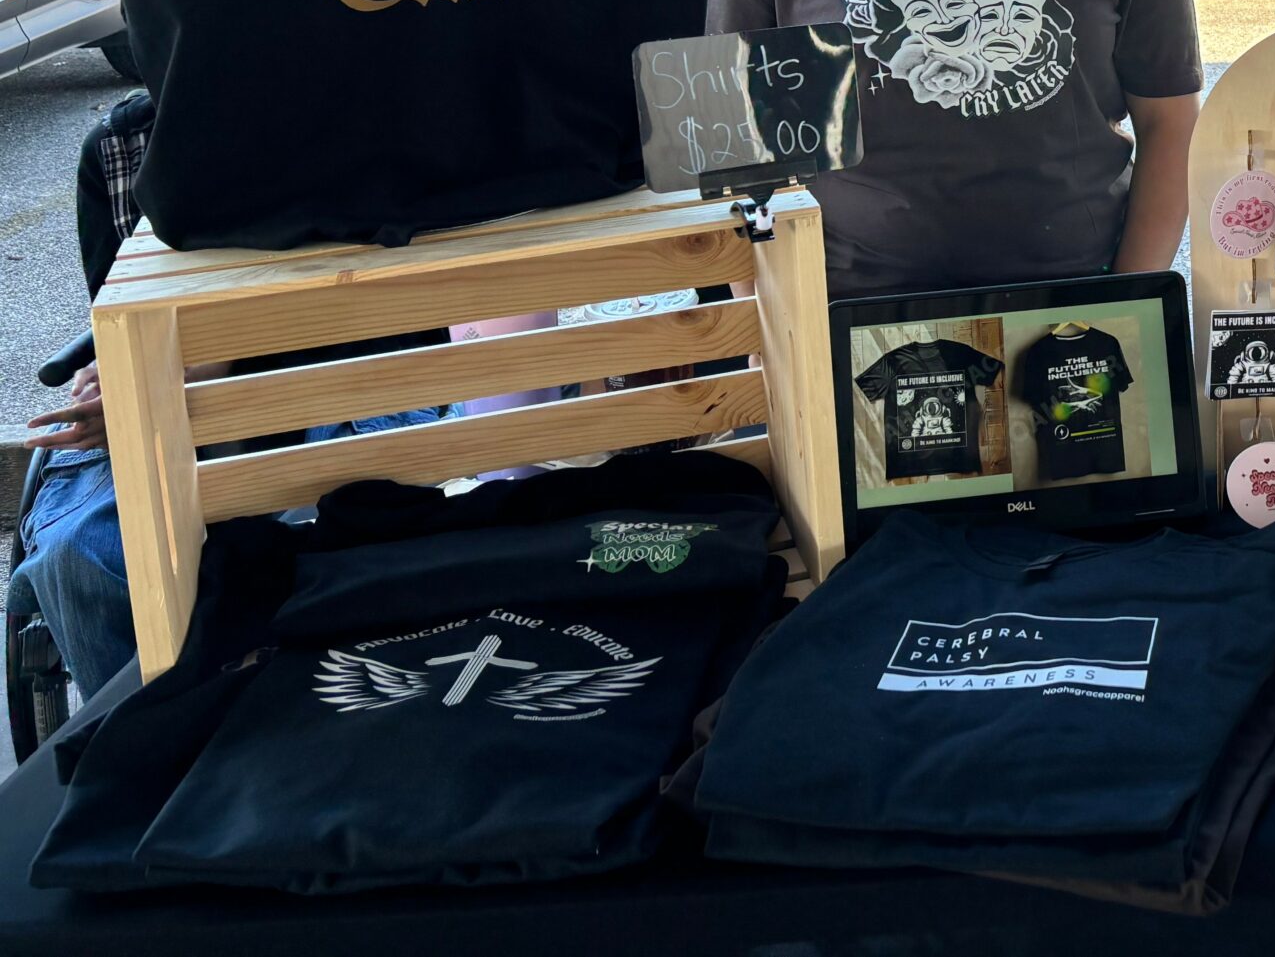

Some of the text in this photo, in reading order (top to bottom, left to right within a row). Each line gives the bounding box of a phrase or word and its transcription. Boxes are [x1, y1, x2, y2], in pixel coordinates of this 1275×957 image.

[652, 44, 805, 109] Shirts
[1213, 317, 1227, 327] THE
[1228, 316, 1254, 326] FUTURE
[1255, 316, 1263, 325] IS
[1047, 361, 1094, 374] FUTURE
[1065, 355, 1088, 365] THE
[898, 378, 908, 386] THE
[908, 376, 929, 386] FUTURE
[929, 376, 936, 384] IS
[1047, 366, 1109, 381] INCLUSIVE
[1007, 501, 1036, 513] DELL
[600, 521, 693, 533] Special
[602, 530, 686, 545] Needs
[604, 544, 677, 563] MOM
[917, 627, 1044, 649] CEREBRAL
[910, 646, 989, 664] PALSY
[916, 668, 1097, 689] AWARENESS
[1042, 687, 1145, 703] Noahsgraceapparel
